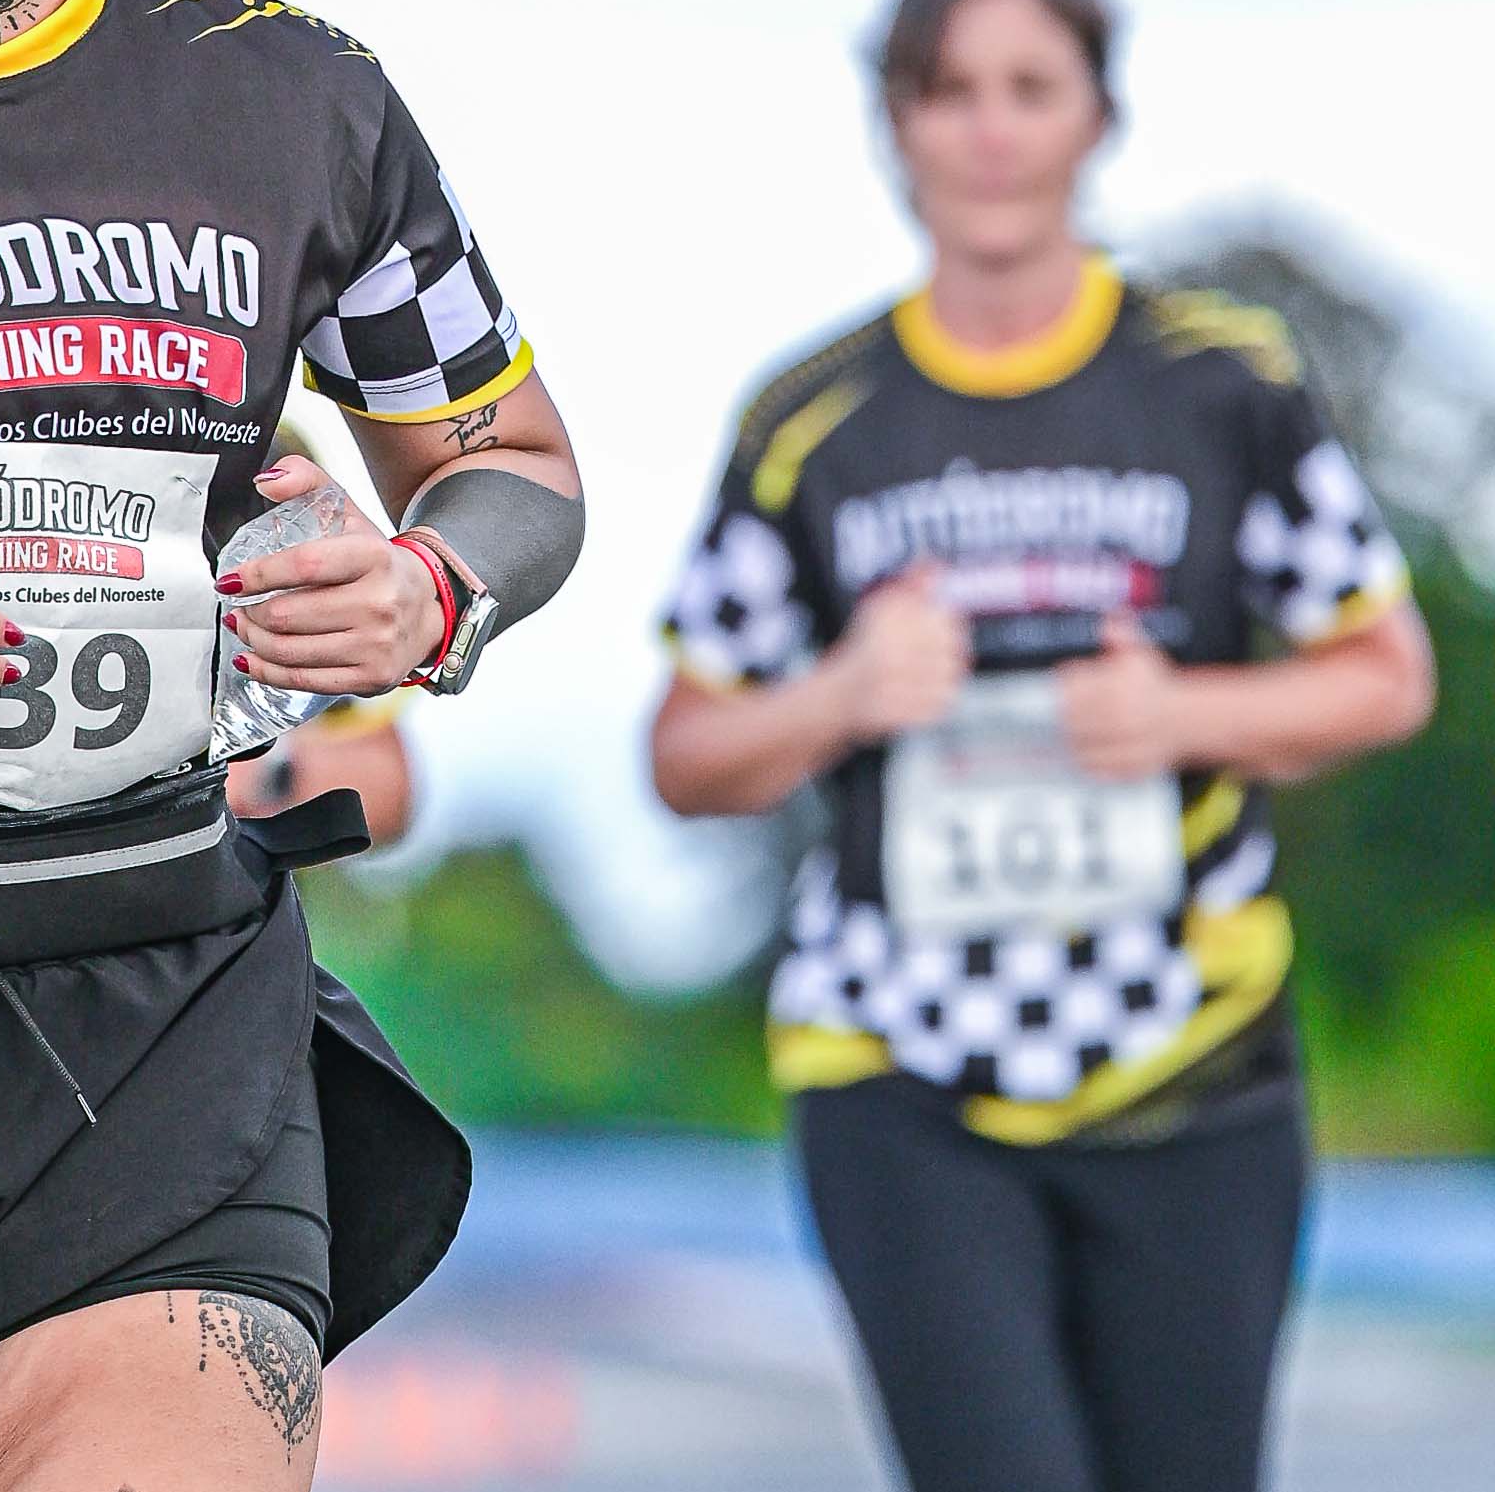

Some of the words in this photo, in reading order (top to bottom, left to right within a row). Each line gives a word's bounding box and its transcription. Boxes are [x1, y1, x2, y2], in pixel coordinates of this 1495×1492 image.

[99, 324, 210, 389] RACE
[32, 409, 124, 440] Clubes
[131, 407, 175, 437] del
[180, 407, 261, 444] Noroeste
[56, 540, 120, 574] RACE
[15, 587, 70, 603] Clubes
[73, 587, 97, 603] del
[100, 587, 165, 603] Noroeste
